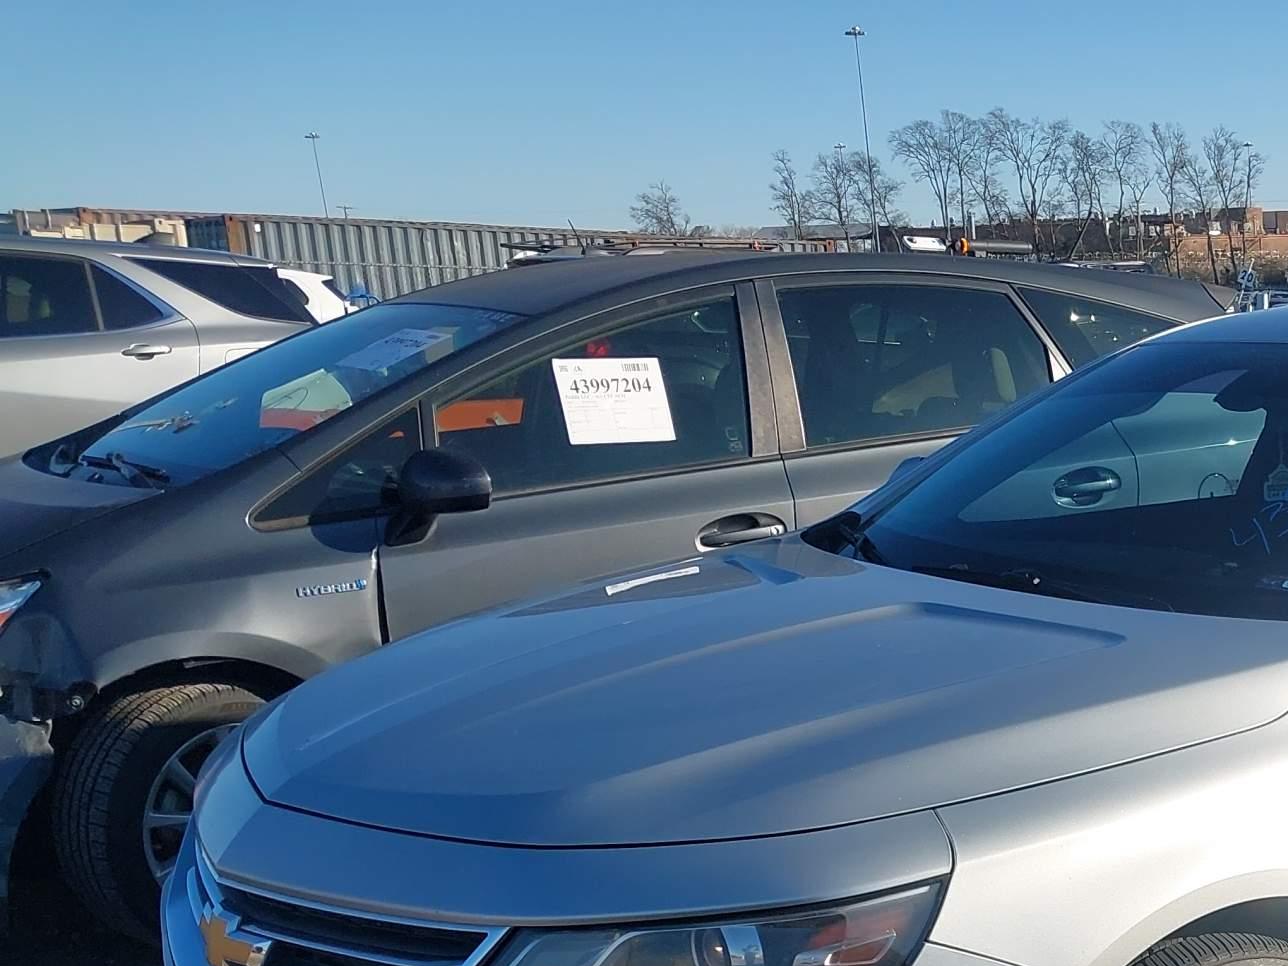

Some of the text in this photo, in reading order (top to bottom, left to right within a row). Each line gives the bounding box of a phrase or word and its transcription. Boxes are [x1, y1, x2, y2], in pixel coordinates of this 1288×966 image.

[1239, 270, 1254, 283] 20
[569, 377, 652, 393] 43997204
[295, 581, 359, 598] HYBRID
